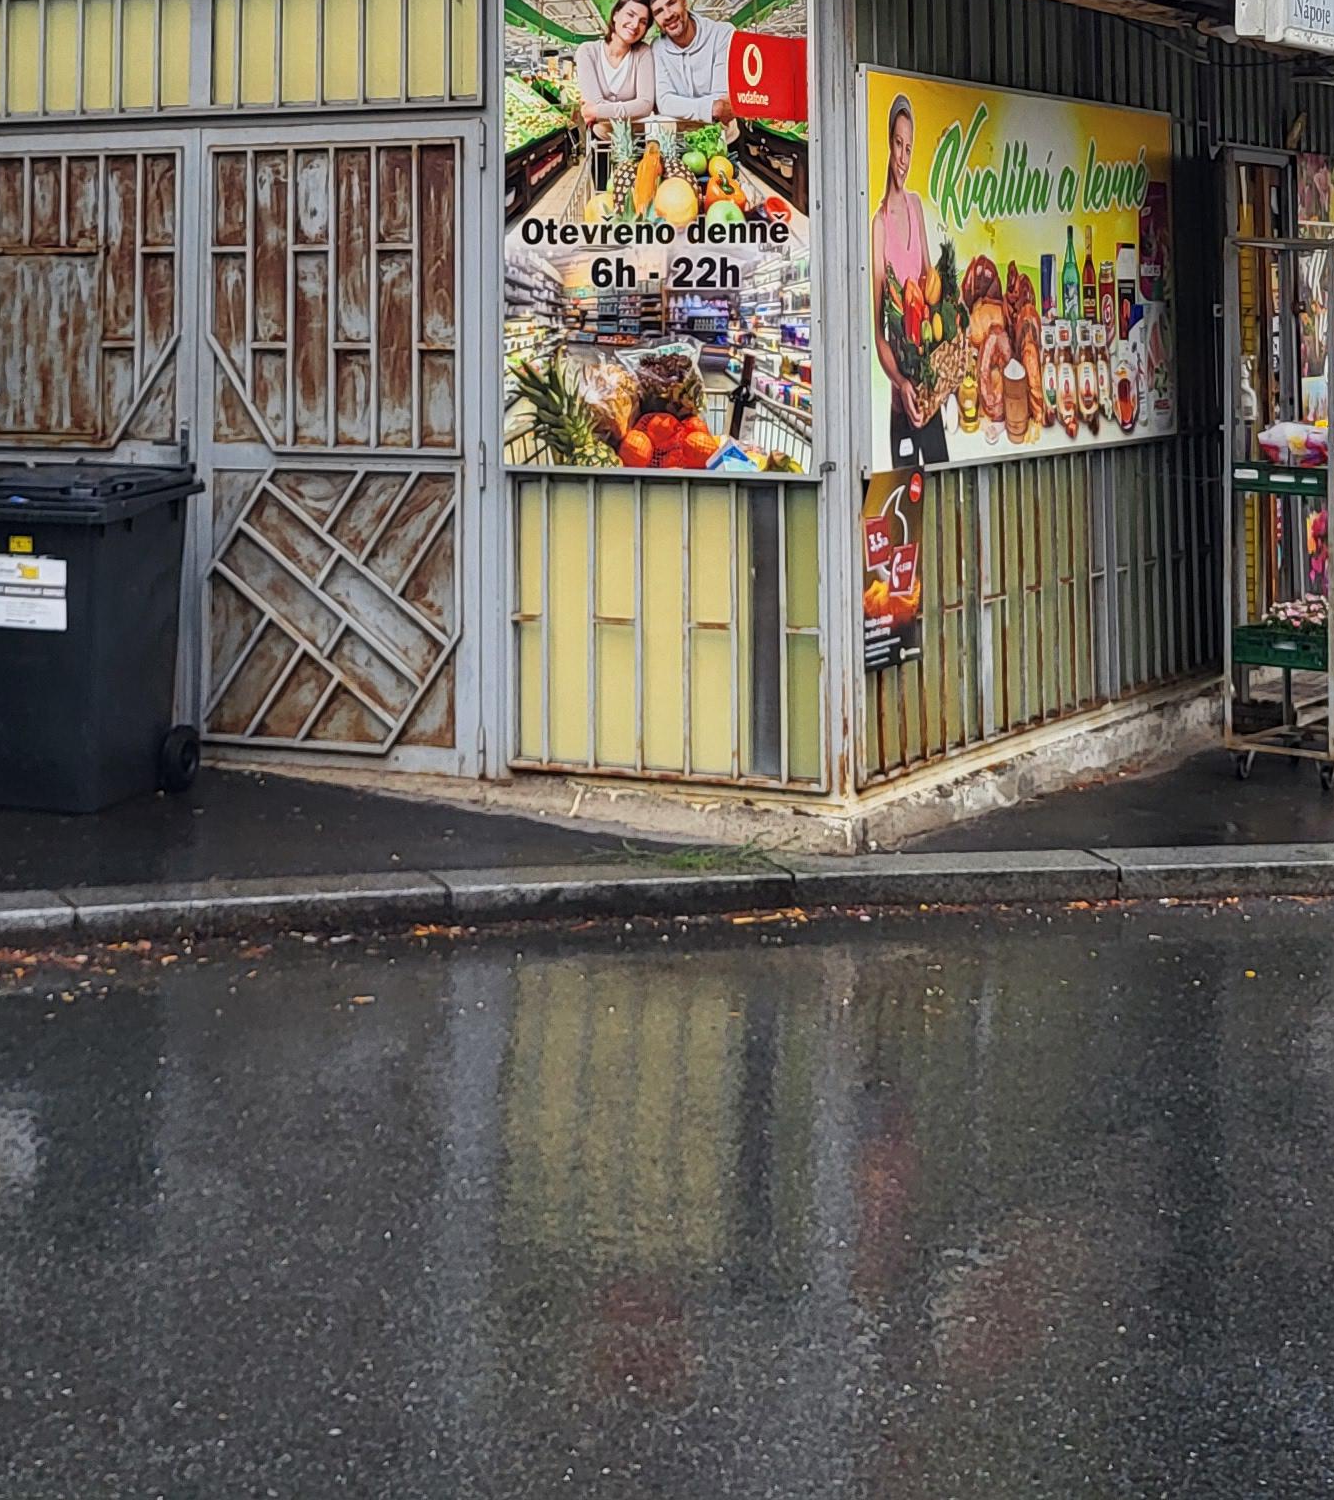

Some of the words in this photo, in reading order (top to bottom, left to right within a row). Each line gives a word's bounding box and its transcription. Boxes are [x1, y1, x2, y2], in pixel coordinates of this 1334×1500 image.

[737, 91, 769, 105] vodafone
[930, 105, 1053, 229] Kvalitní
[1058, 165, 1080, 212] a
[1084, 140, 1148, 210] levné
[521, 215, 675, 245] Otevřeno
[687, 213, 789, 244] denně
[591, 258, 636, 288] 6h
[672, 257, 740, 288] 22h
